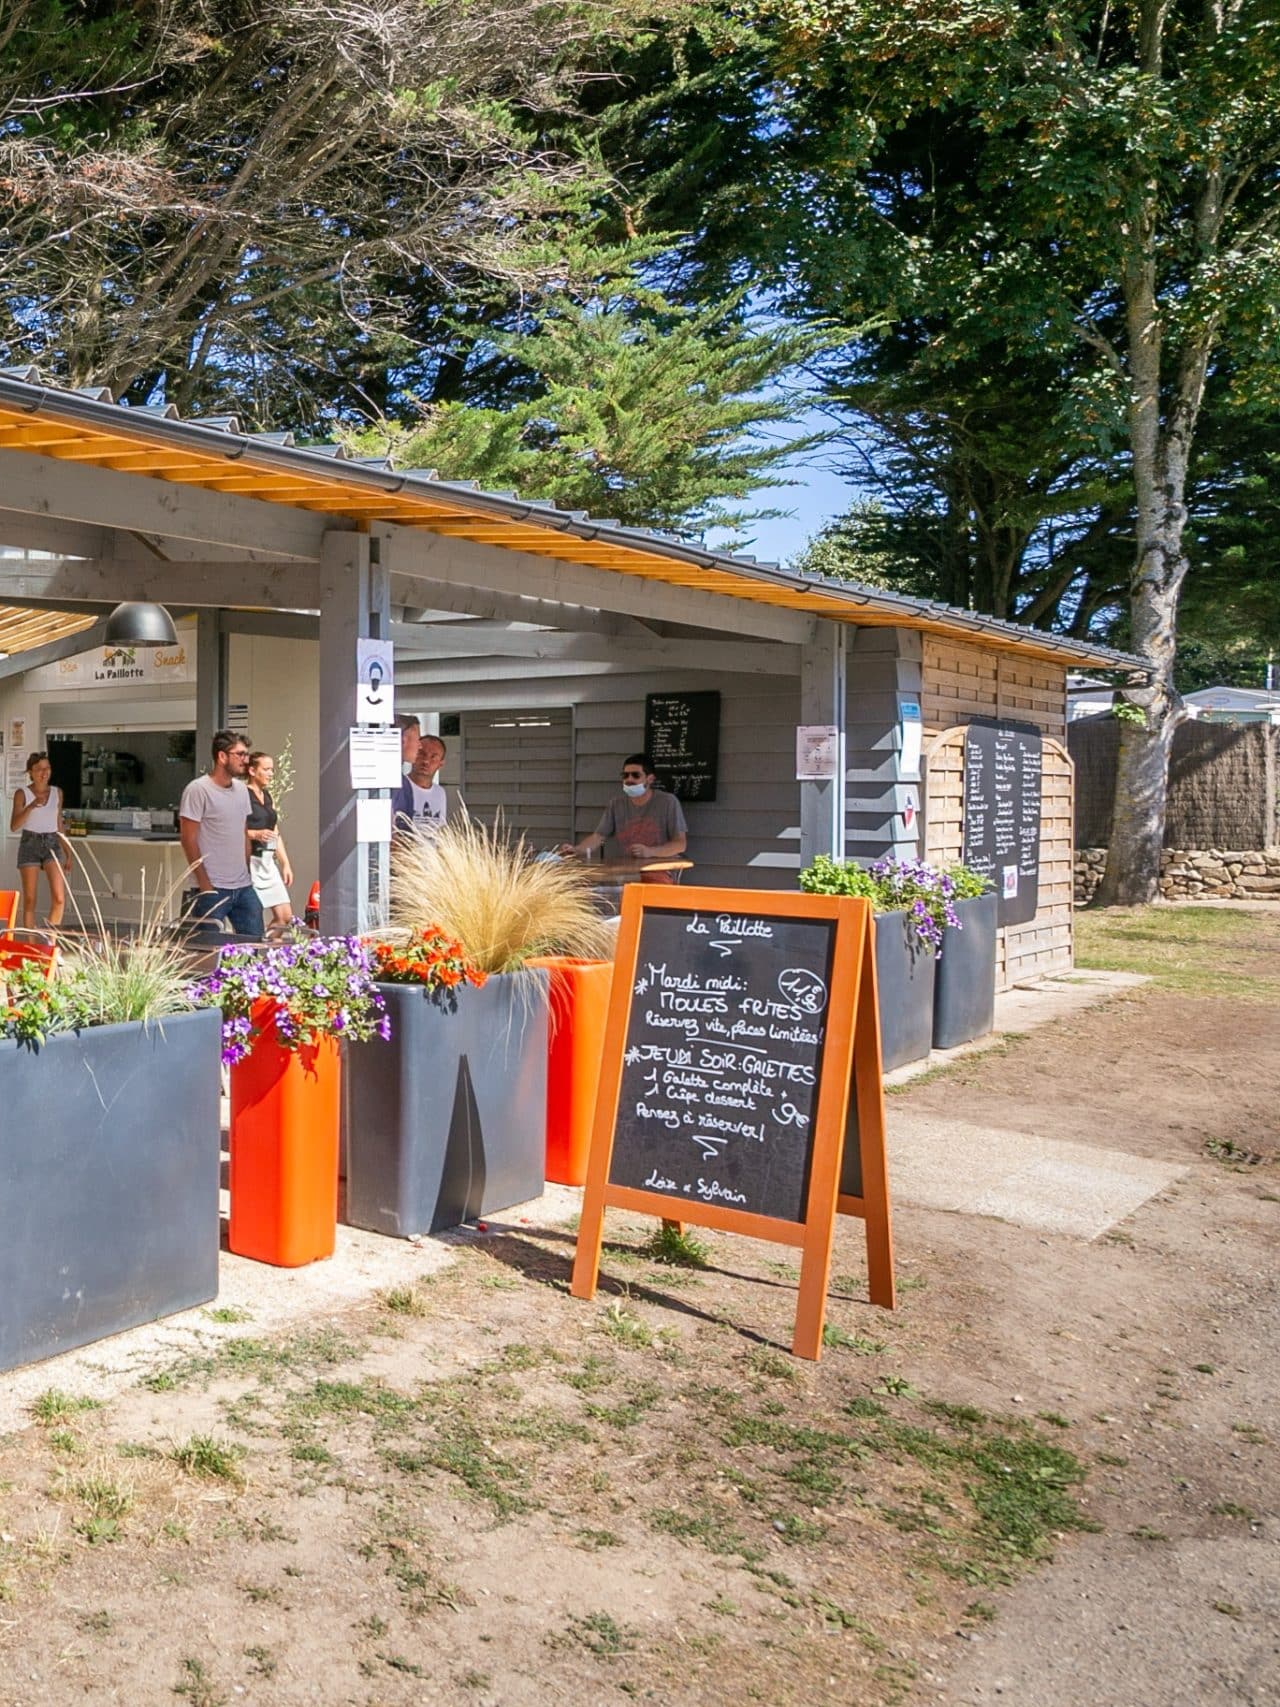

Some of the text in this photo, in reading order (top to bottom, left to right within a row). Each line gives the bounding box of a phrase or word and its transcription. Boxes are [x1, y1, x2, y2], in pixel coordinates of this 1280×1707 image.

[154, 648, 186, 668] Snack
[95, 668, 144, 680] La Paillotte
[686, 912, 773, 938] La Paillotte
[648, 962, 700, 990] Mardi
[660, 992, 728, 1014] MOULES
[645, 1011, 699, 1036] Réservez
[663, 1070, 710, 1088] Galette
[713, 1078, 774, 1098] complète
[666, 1086, 700, 1105] Crêpe
[705, 1091, 757, 1111] dessert
[636, 1102, 681, 1129] Pensez
[683, 1110, 694, 1124] à
[697, 1178, 747, 1203] Sylvain
